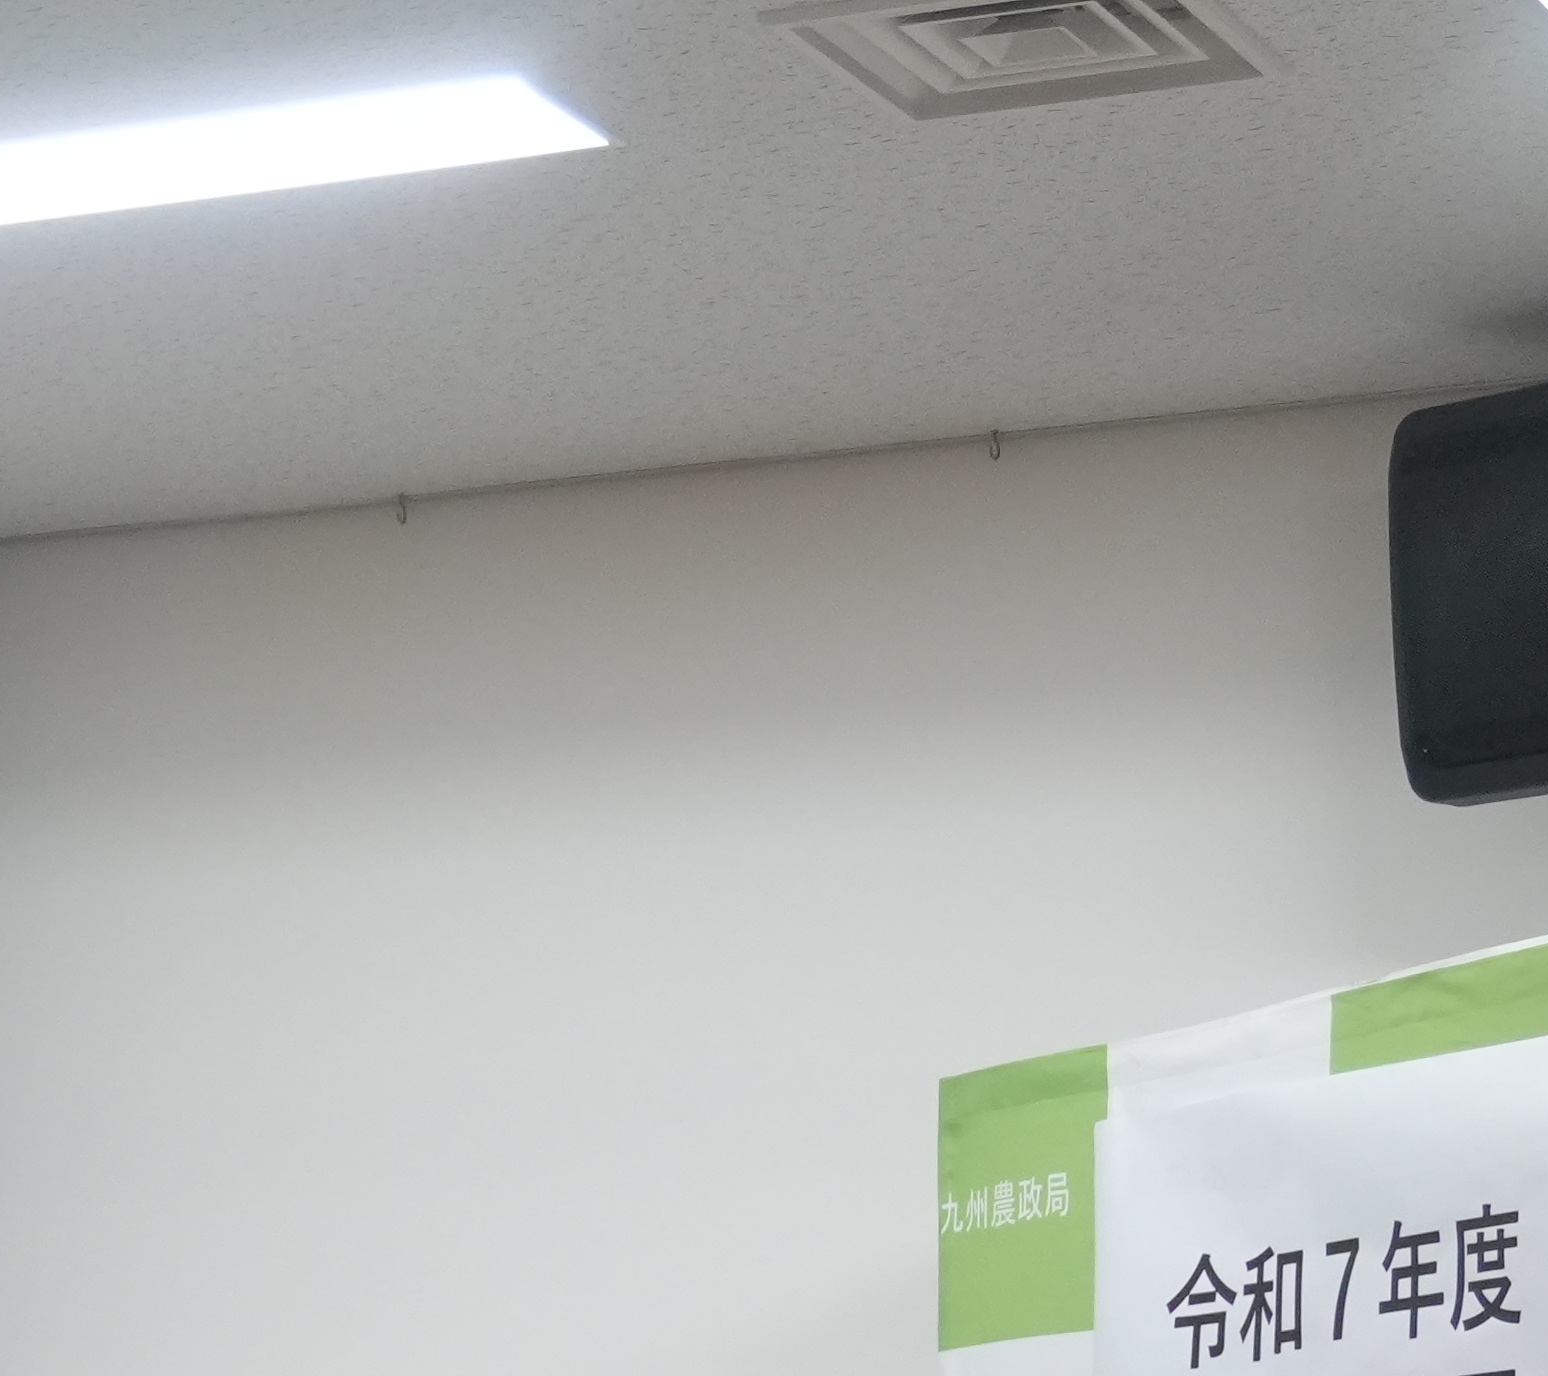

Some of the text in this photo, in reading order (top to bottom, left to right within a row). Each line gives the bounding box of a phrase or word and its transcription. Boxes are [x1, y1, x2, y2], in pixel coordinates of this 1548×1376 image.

[940, 1171, 1070, 1236] 九州農政局
[1164, 1202, 1522, 1371] 令和7年度
